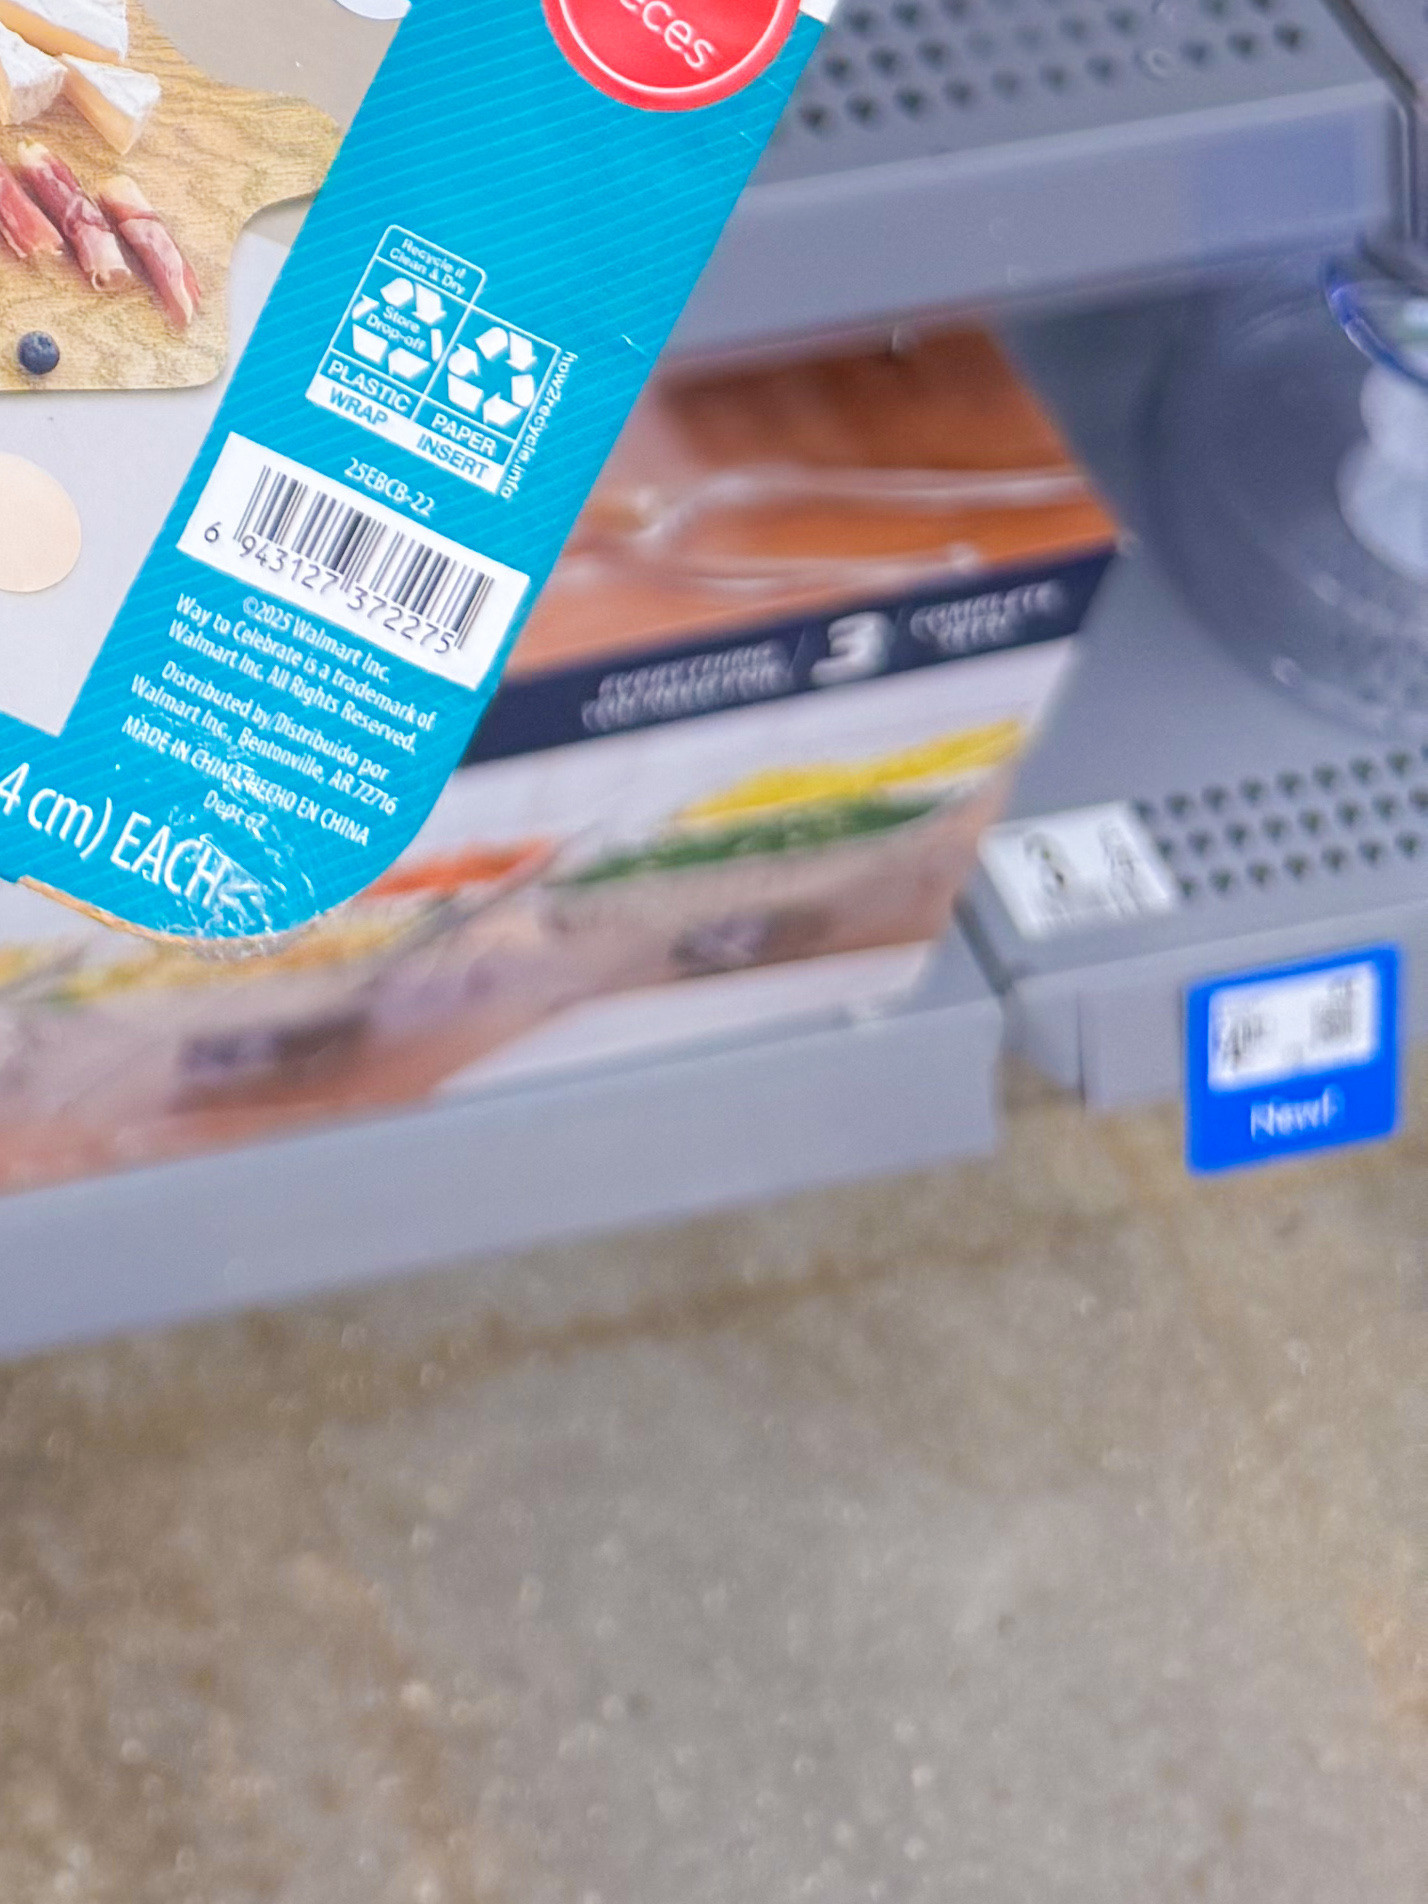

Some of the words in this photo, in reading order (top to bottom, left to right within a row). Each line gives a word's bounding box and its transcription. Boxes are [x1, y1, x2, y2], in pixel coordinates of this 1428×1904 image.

[389, 248, 427, 275] Clean
[441, 274, 466, 296] Dry
[401, 238, 454, 273] Recycle
[366, 313, 427, 352] Drop-off
[383, 306, 420, 334] Store
[328, 360, 413, 412] PLASTIC
[329, 386, 388, 425] WRAP
[417, 433, 492, 480] INSERT
[431, 413, 497, 456] PAPER
[500, 351, 578, 499] how2recycle.info
[344, 457, 436, 518] 25EBCB-22
[204, 521, 222, 543] 6
[239, 534, 340, 595] 943127
[347, 587, 455, 654] 372275
[176, 592, 212, 628] Way
[212, 614, 231, 634] to
[233, 621, 304, 667] Celebrate
[303, 651, 318, 673] is
[318, 661, 331, 680] a
[333, 667, 418, 727] trademark
[416, 709, 438, 733] of
[292, 616, 363, 667] Walmart
[362, 652, 391, 684] Inc.
[169, 618, 240, 669] Walmart
[239, 653, 265, 682] Inc.
[266, 664, 290, 691] All
[289, 674, 341, 714] Rights
[340, 700, 417, 756] Reserved.
[131, 673, 202, 724] Walmart
[237, 726, 325, 784] Bentonville,
[328, 767, 354, 793] AR
[354, 778, 400, 817] 72716
[161, 660, 254, 717] Distributed
[358, 756, 391, 783] por
[121, 714, 172, 754] MADE
[170, 738, 192, 764] IN
[296, 796, 320, 822] EN
[320, 807, 370, 847] CHINA
[26, 786, 113, 861] cm)
[110, 811, 230, 911] EACH
